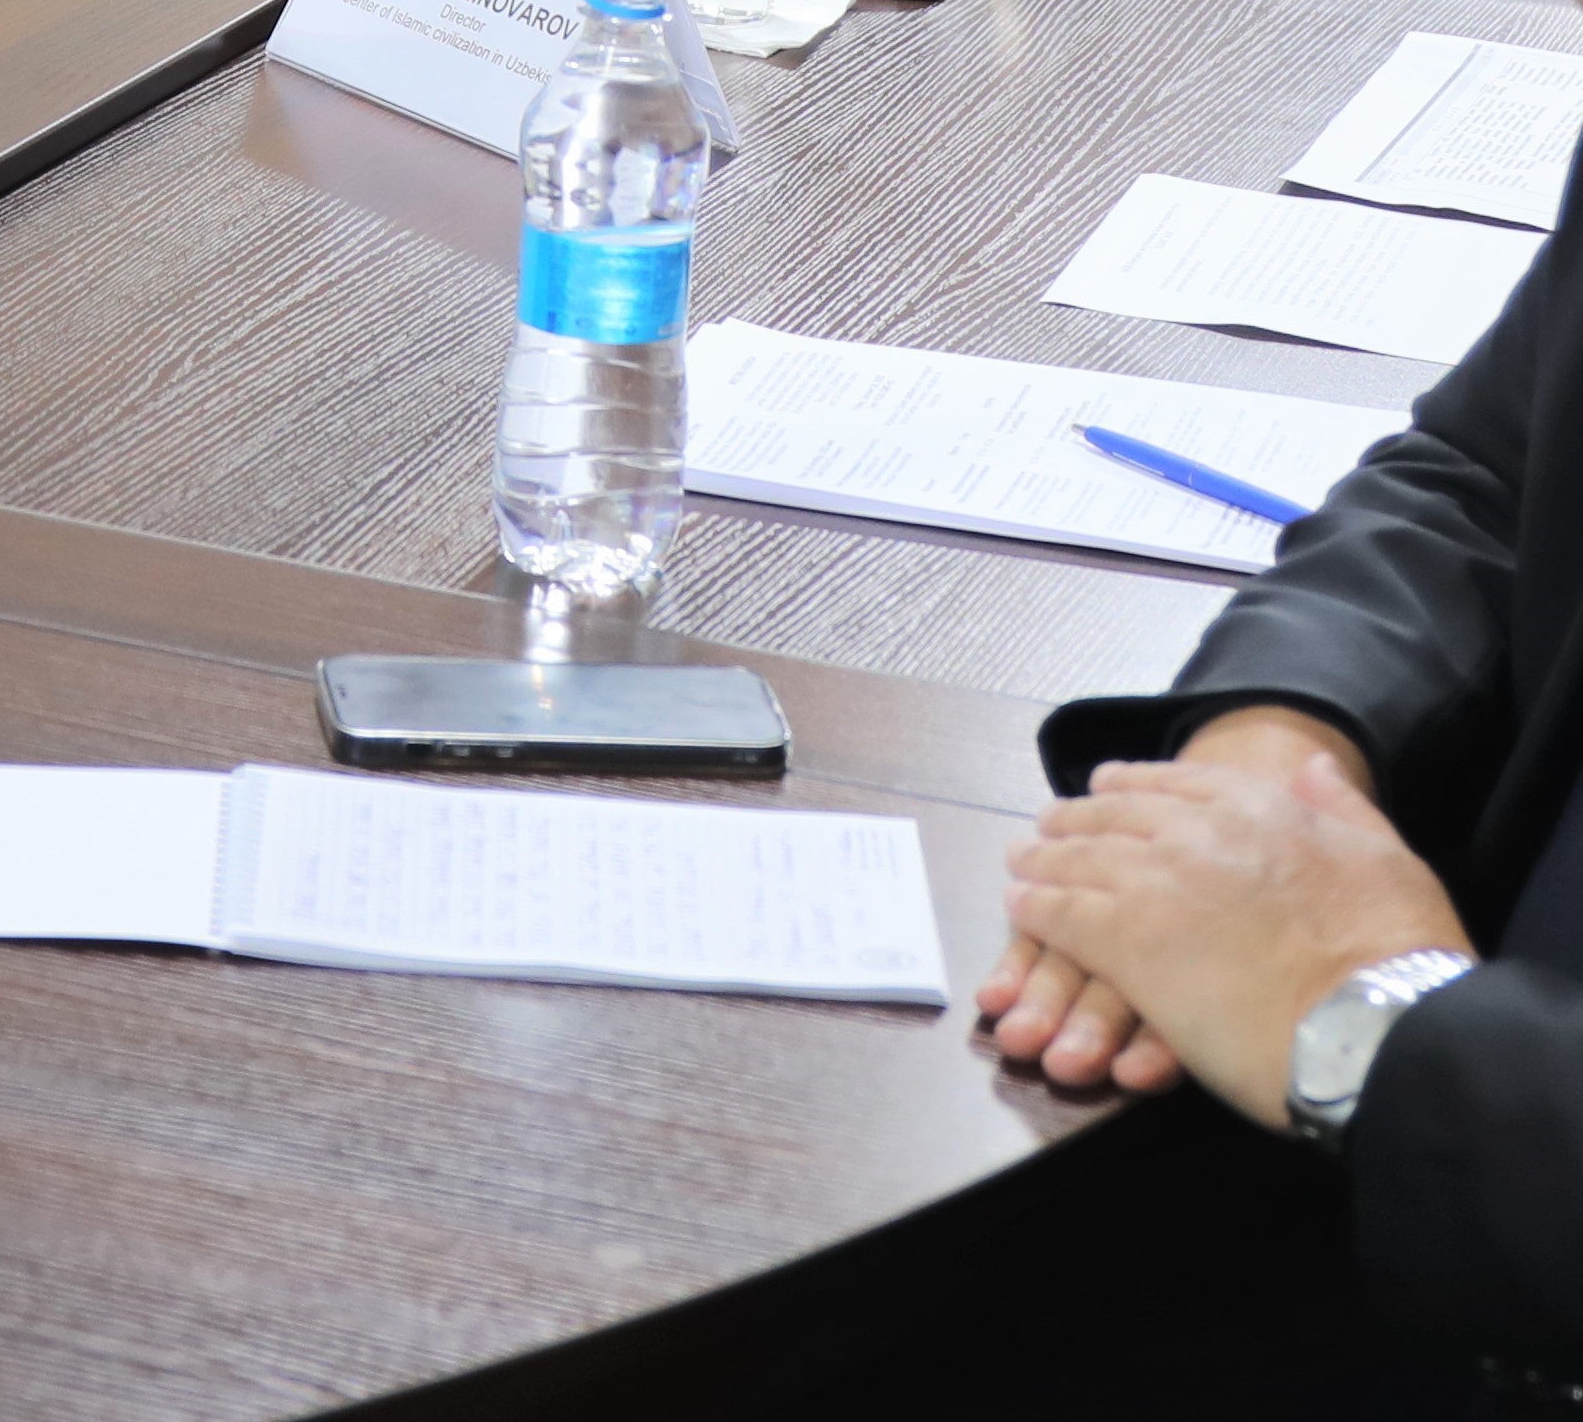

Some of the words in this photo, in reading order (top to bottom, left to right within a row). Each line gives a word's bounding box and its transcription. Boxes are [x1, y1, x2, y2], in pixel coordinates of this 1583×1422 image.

[379, 5, 393, 18] of
[391, 8, 432, 37] Islamic
[432, 26, 491, 64] civilization
[492, 48, 504, 66] in
[505, 54, 553, 85] Uzbekis
[439, 3, 487, 34] Director
